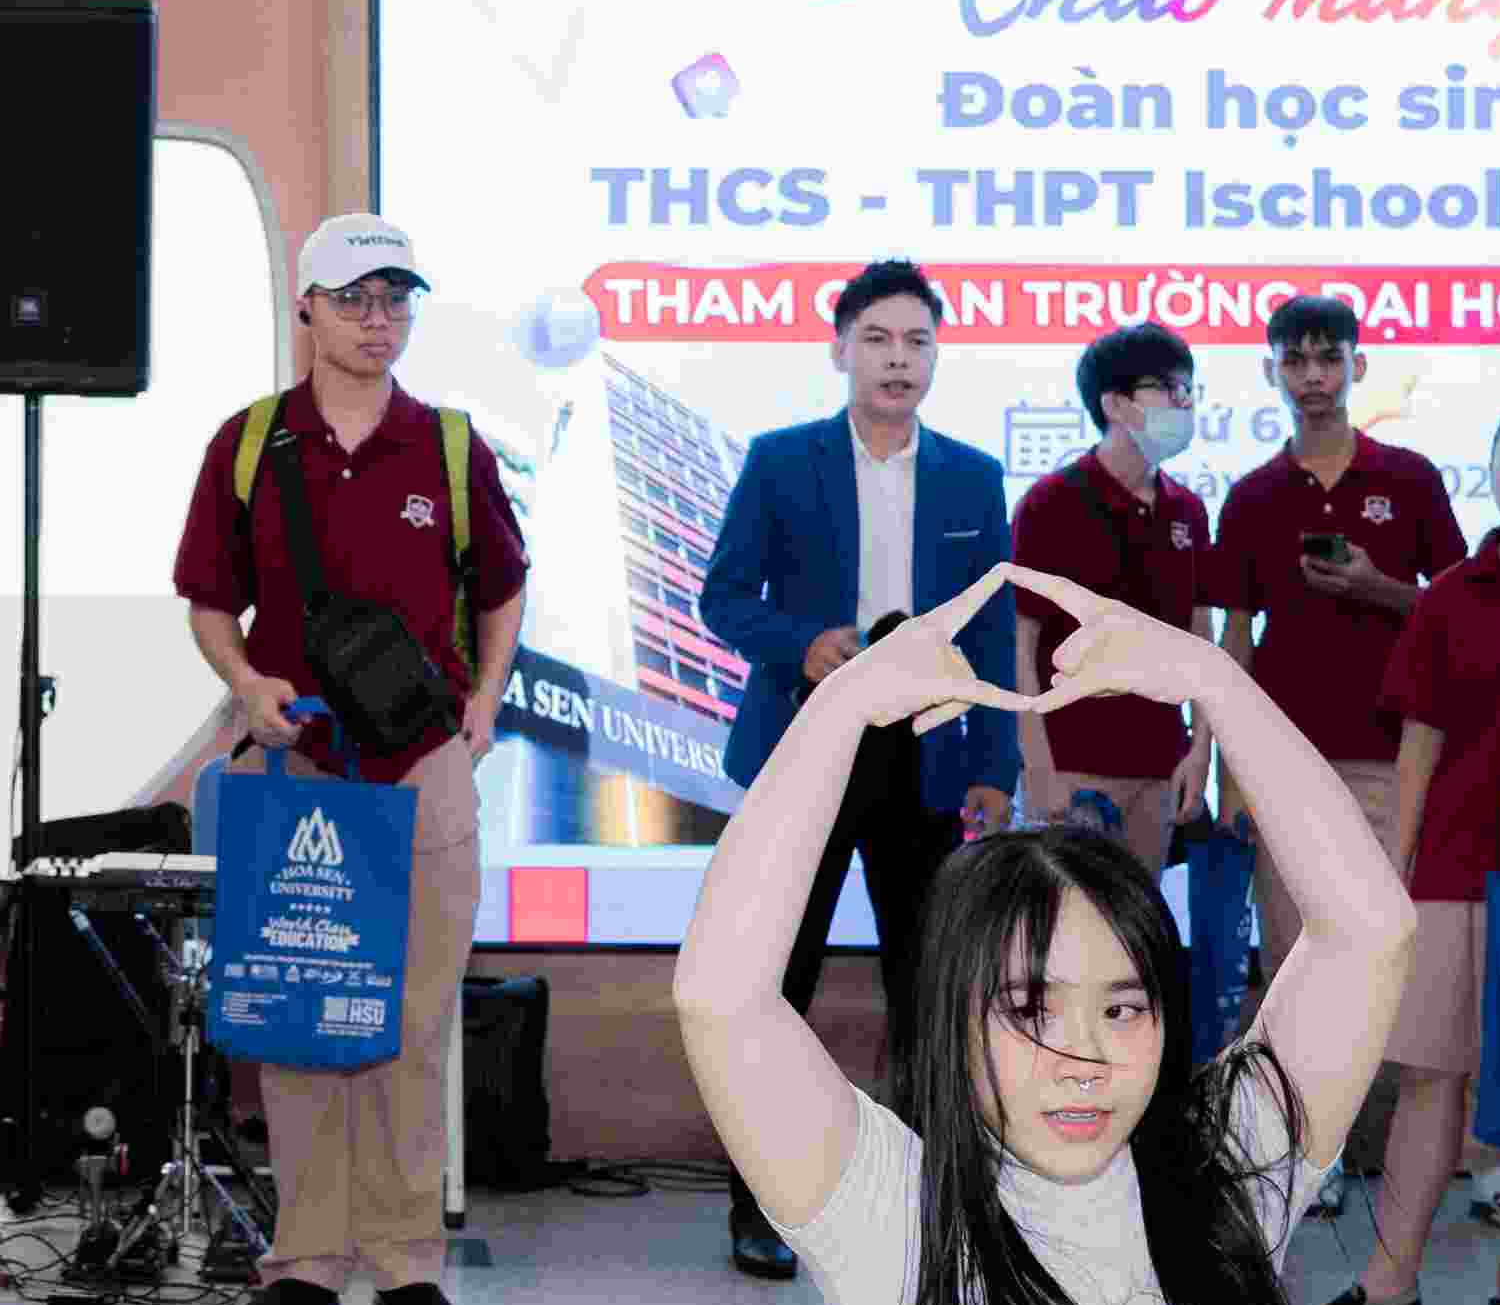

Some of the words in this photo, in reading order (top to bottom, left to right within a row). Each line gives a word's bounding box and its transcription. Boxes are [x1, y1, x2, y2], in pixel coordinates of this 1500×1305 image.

[936, 66, 1174, 130] Đoàn
[1206, 68, 1369, 147] học
[590, 167, 831, 228] THCS
[916, 169, 1155, 227] THPT
[605, 279, 794, 327] THAM
[815, 279, 1001, 327] AN
[1023, 271, 1289, 328] TRƯỜNG
[533, 679, 597, 733] SEN
[601, 704, 727, 777] UNIVERS
[269, 882, 355, 902] UNIVERSITY
[282, 866, 313, 881] HOA
[268, 932, 350, 953] EDUCATION
[350, 1005, 386, 1026] HSU
